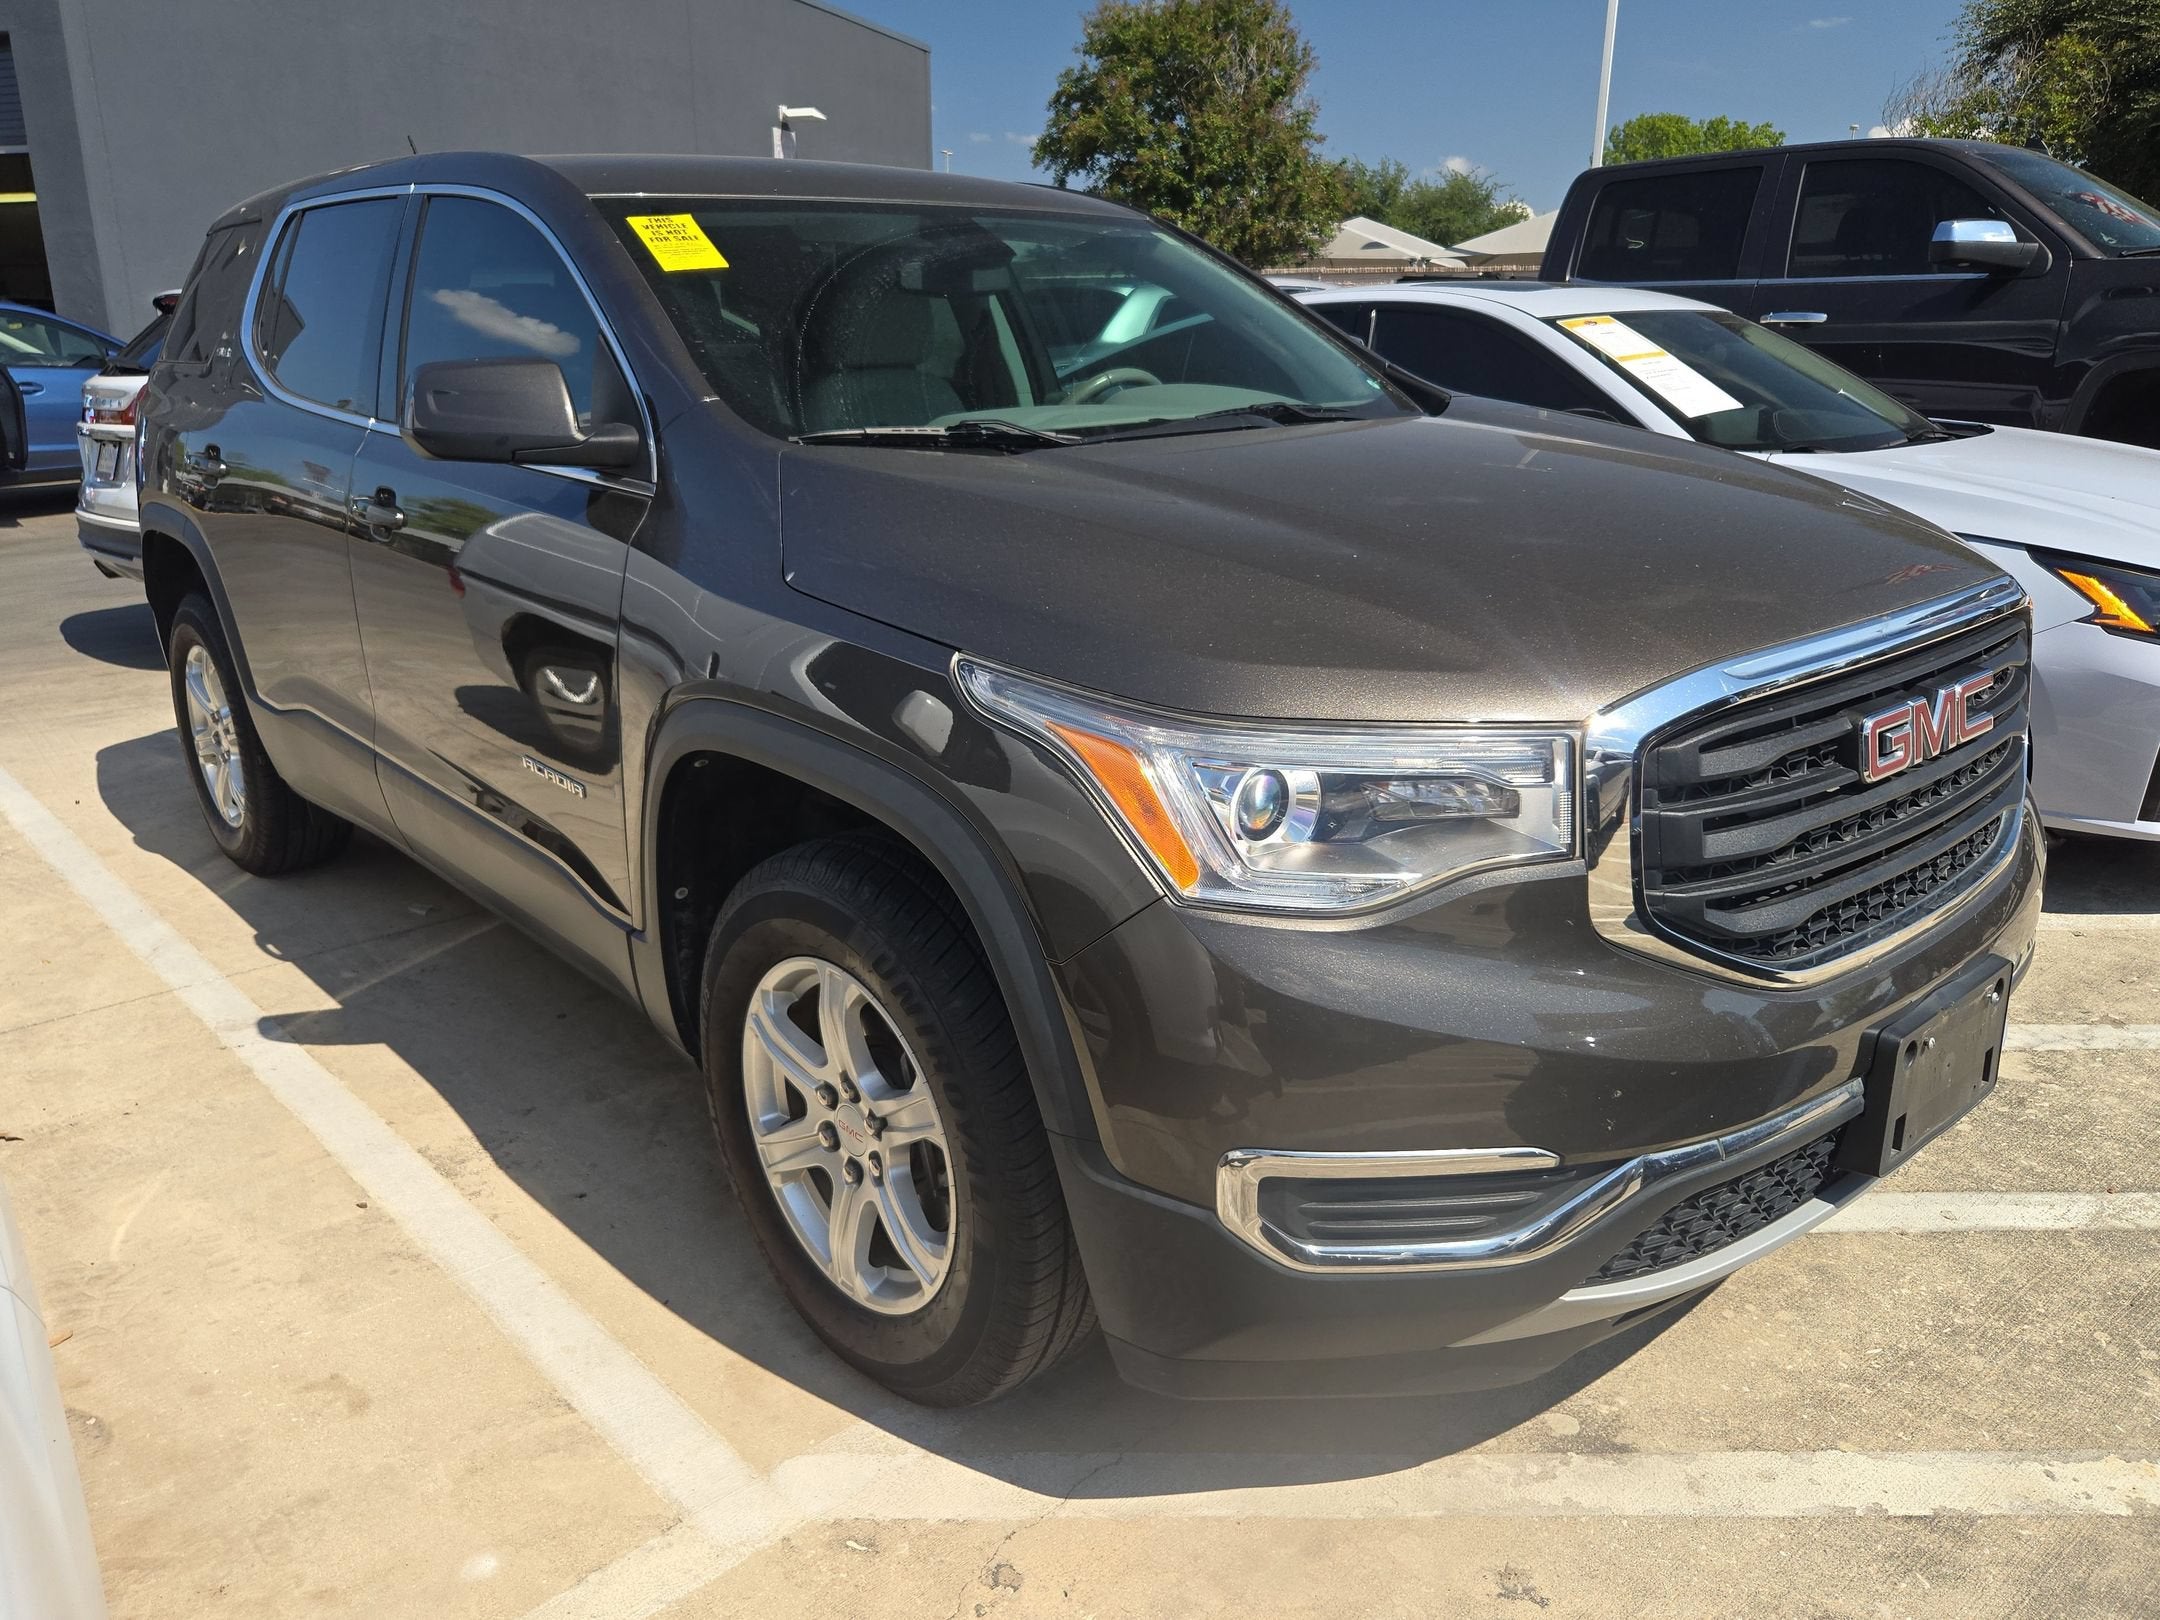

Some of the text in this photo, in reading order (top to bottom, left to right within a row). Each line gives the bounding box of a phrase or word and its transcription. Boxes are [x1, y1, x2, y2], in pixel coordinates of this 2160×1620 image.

[1861, 671, 1994, 783] GMC
[521, 755, 584, 799] ACADIA
[838, 1119, 864, 1144] GMC
